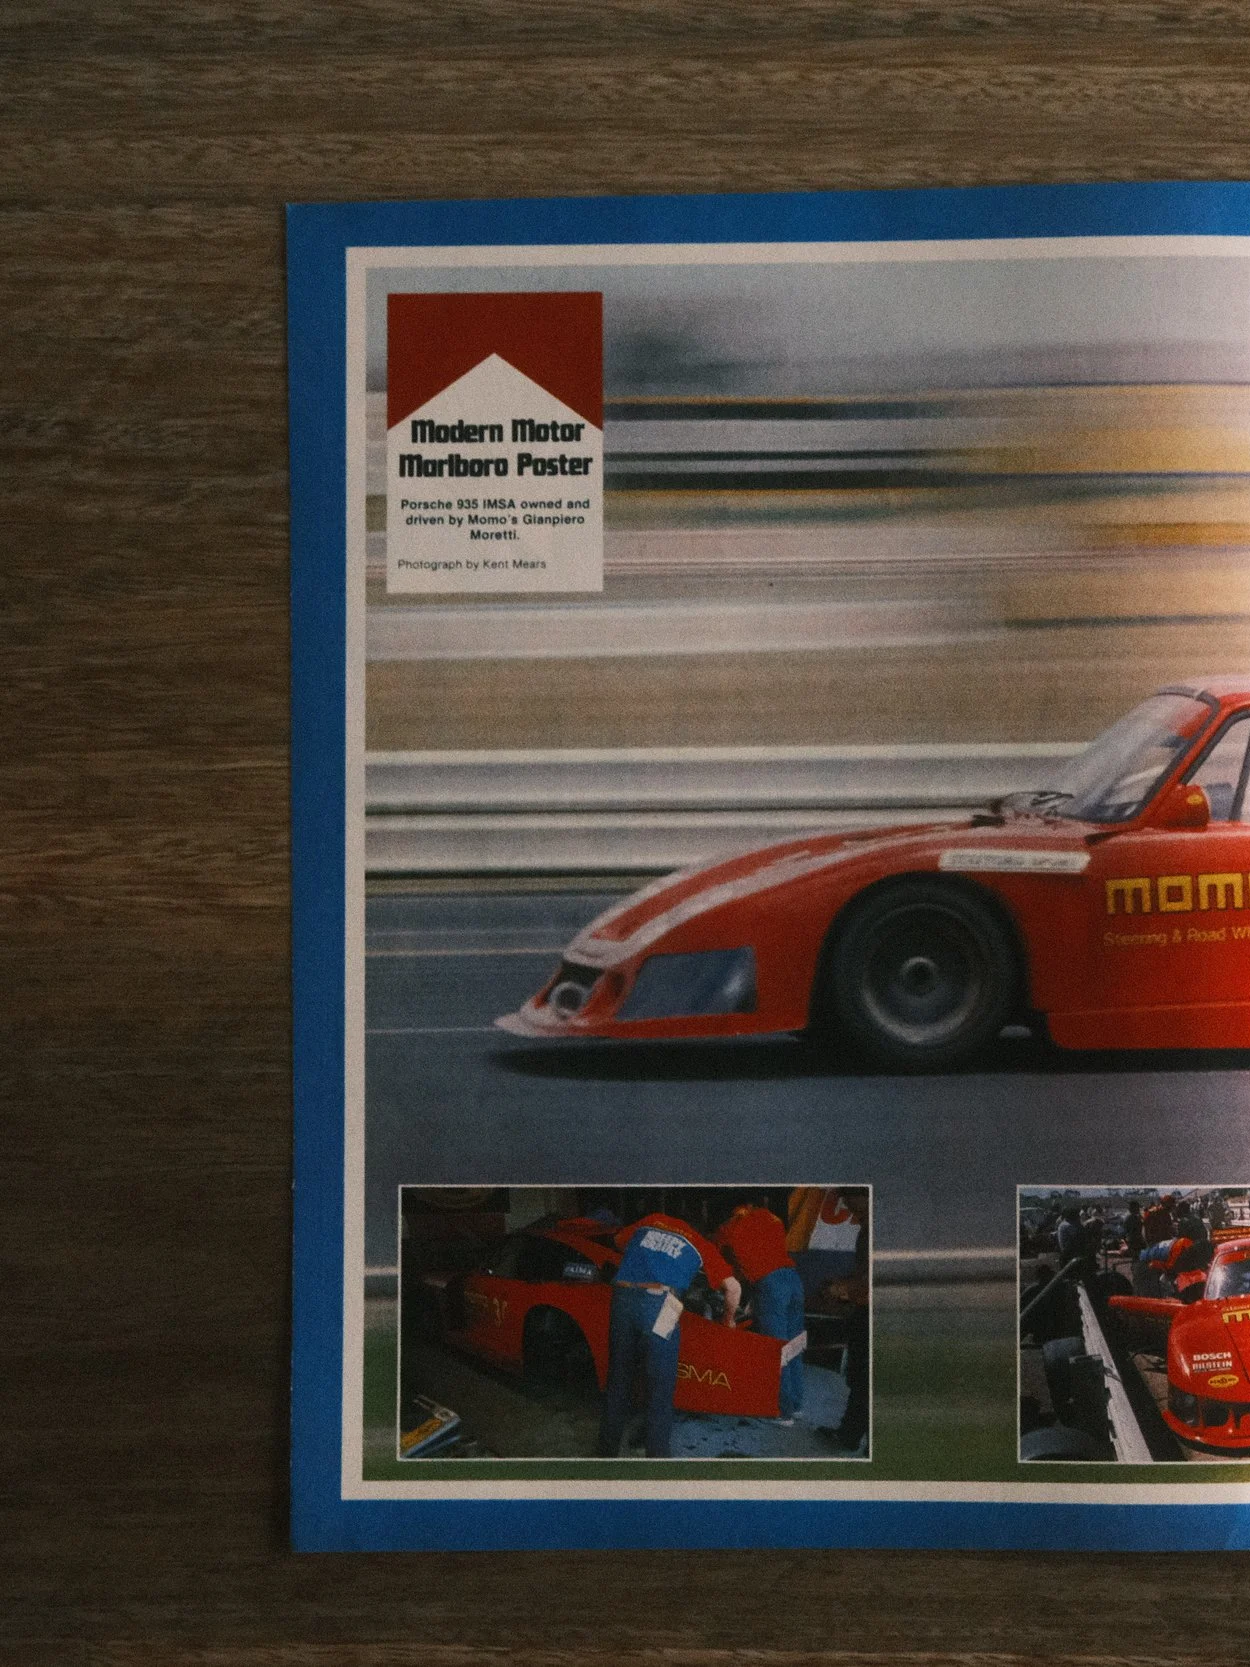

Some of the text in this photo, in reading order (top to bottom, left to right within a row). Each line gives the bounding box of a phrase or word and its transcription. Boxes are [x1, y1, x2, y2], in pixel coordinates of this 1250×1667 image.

[411, 418, 585, 443] Modern Motor
[399, 452, 593, 477] Marlboro Poster
[401, 498, 590, 510] Porsche 935 IMSA owned and
[405, 513, 585, 527] driven by Momo's Gianpiero
[470, 530, 520, 540] Moretti.
[398, 559, 546, 571] Photograph by Kent Mears
[1193, 1351, 1232, 1361] BOSCH
